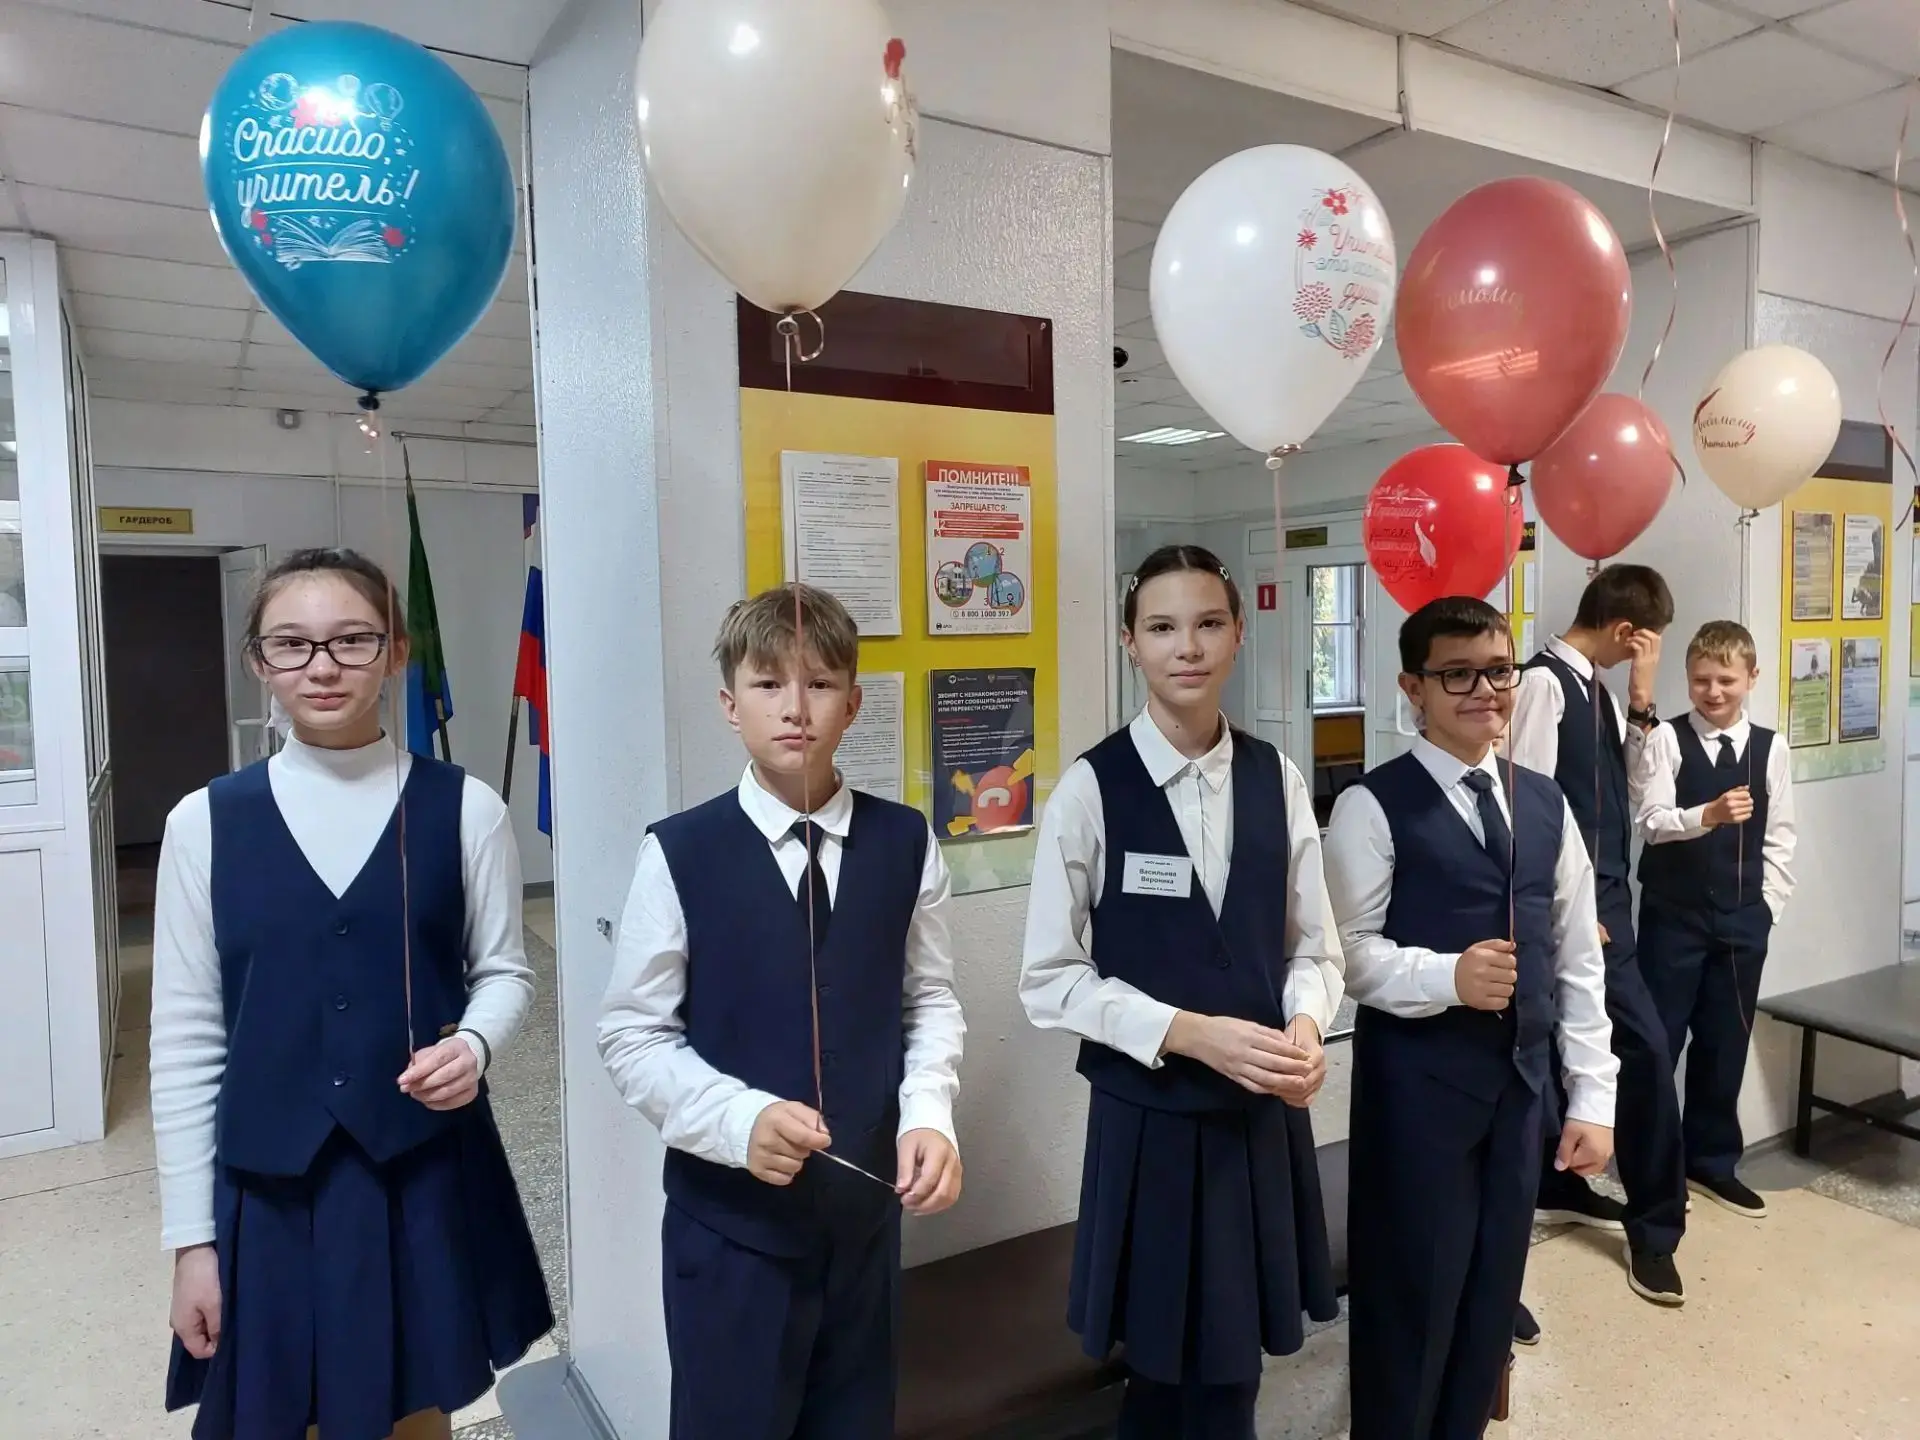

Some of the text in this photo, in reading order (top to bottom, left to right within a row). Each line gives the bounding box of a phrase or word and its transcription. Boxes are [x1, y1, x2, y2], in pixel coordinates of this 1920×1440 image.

[233, 116, 392, 165] Спасибо,
[950, 502, 1008, 512] ЗАПРЕЩАЕТСЯ:
[119, 516, 173, 525] ГАРДЕРОБ
[1139, 868, 1177, 877] Васильева
[1141, 876, 1174, 884] Вероника
